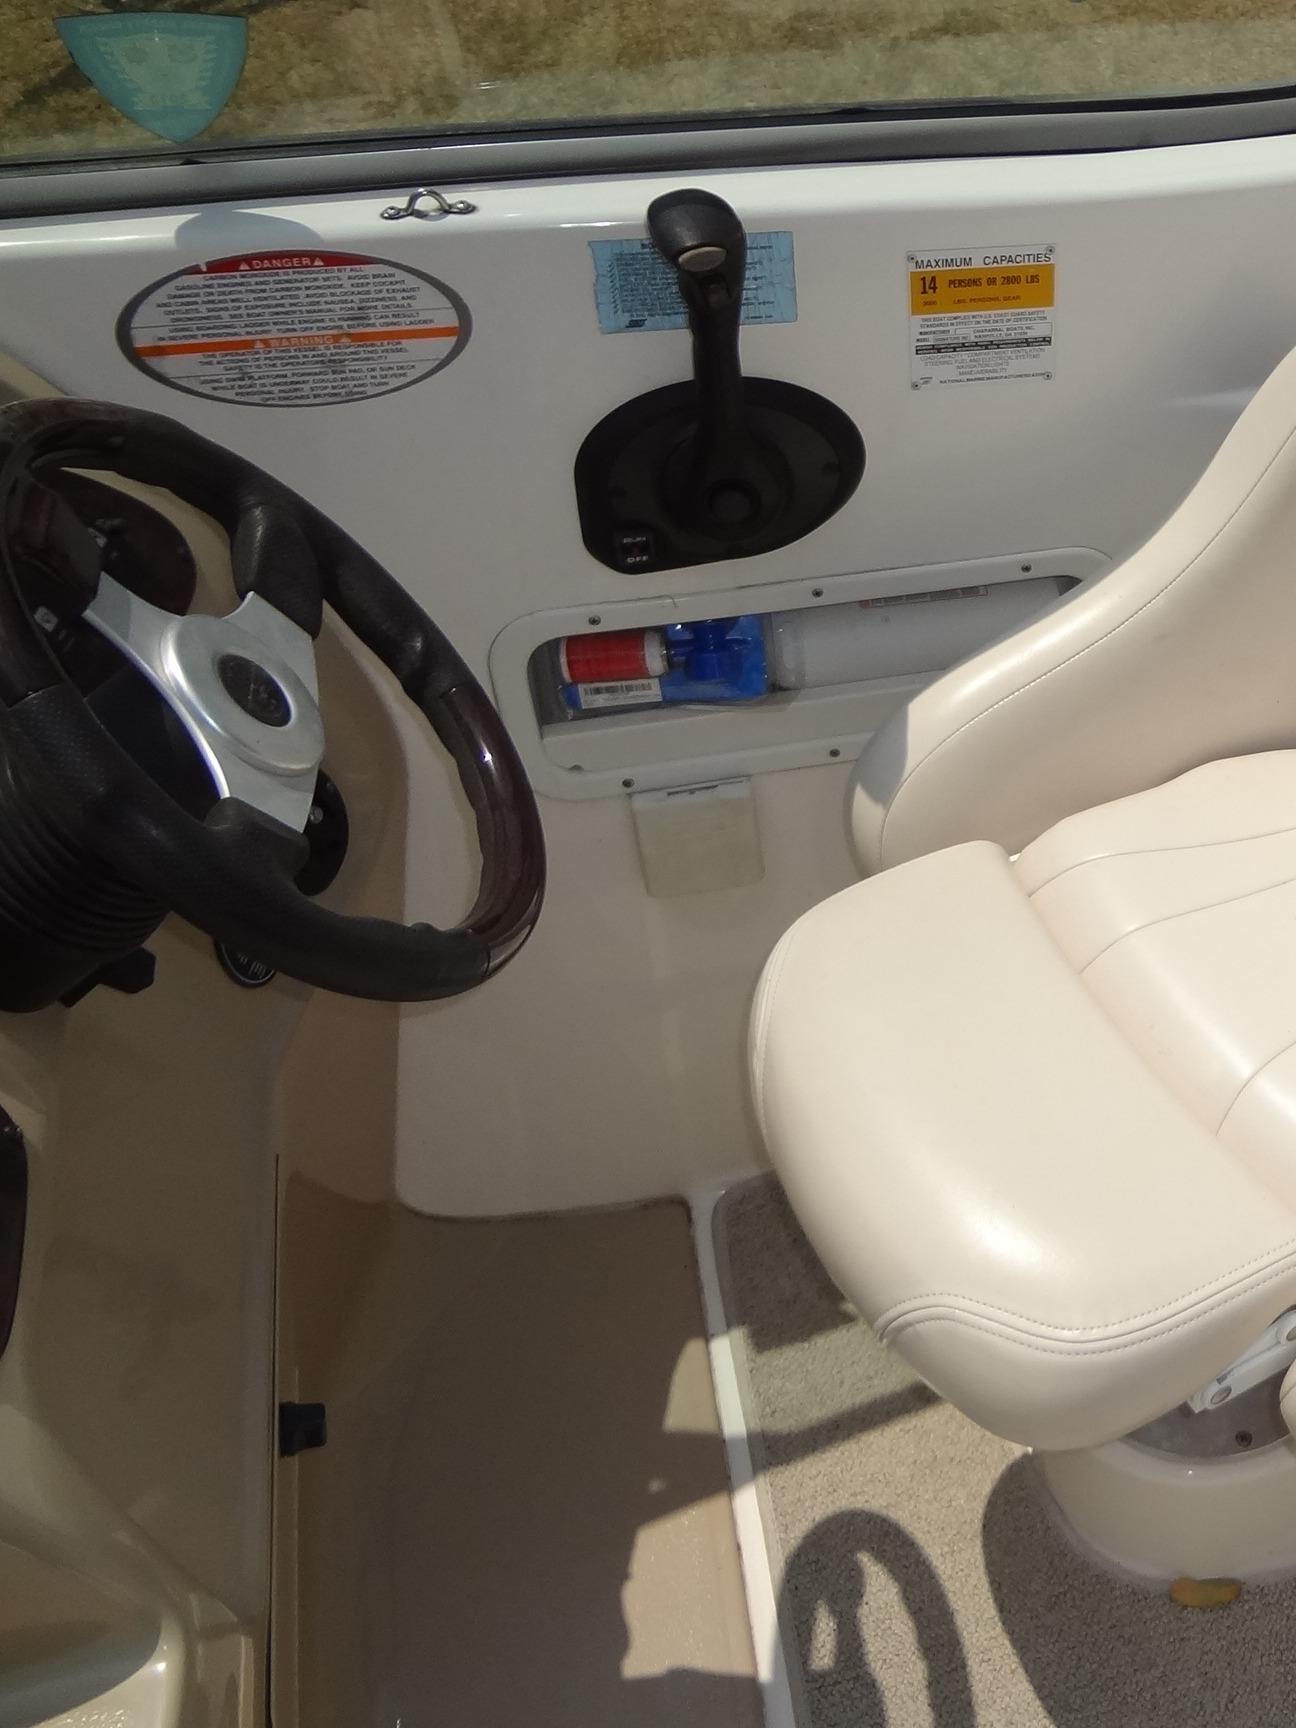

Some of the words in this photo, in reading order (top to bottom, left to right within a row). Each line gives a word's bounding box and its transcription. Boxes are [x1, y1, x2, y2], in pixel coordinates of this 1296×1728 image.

[252, 257, 311, 269] DANGER
[915, 257, 973, 269] MAXIMUM
[983, 252, 1051, 266] CAPACITIES
[920, 275, 938, 295] 14
[948, 277, 983, 289] PERSONS
[987, 277, 998, 286] OR
[1025, 274, 1040, 284] LBS
[270, 335, 333, 347] WARNING
[627, 555, 649, 563] OFF
